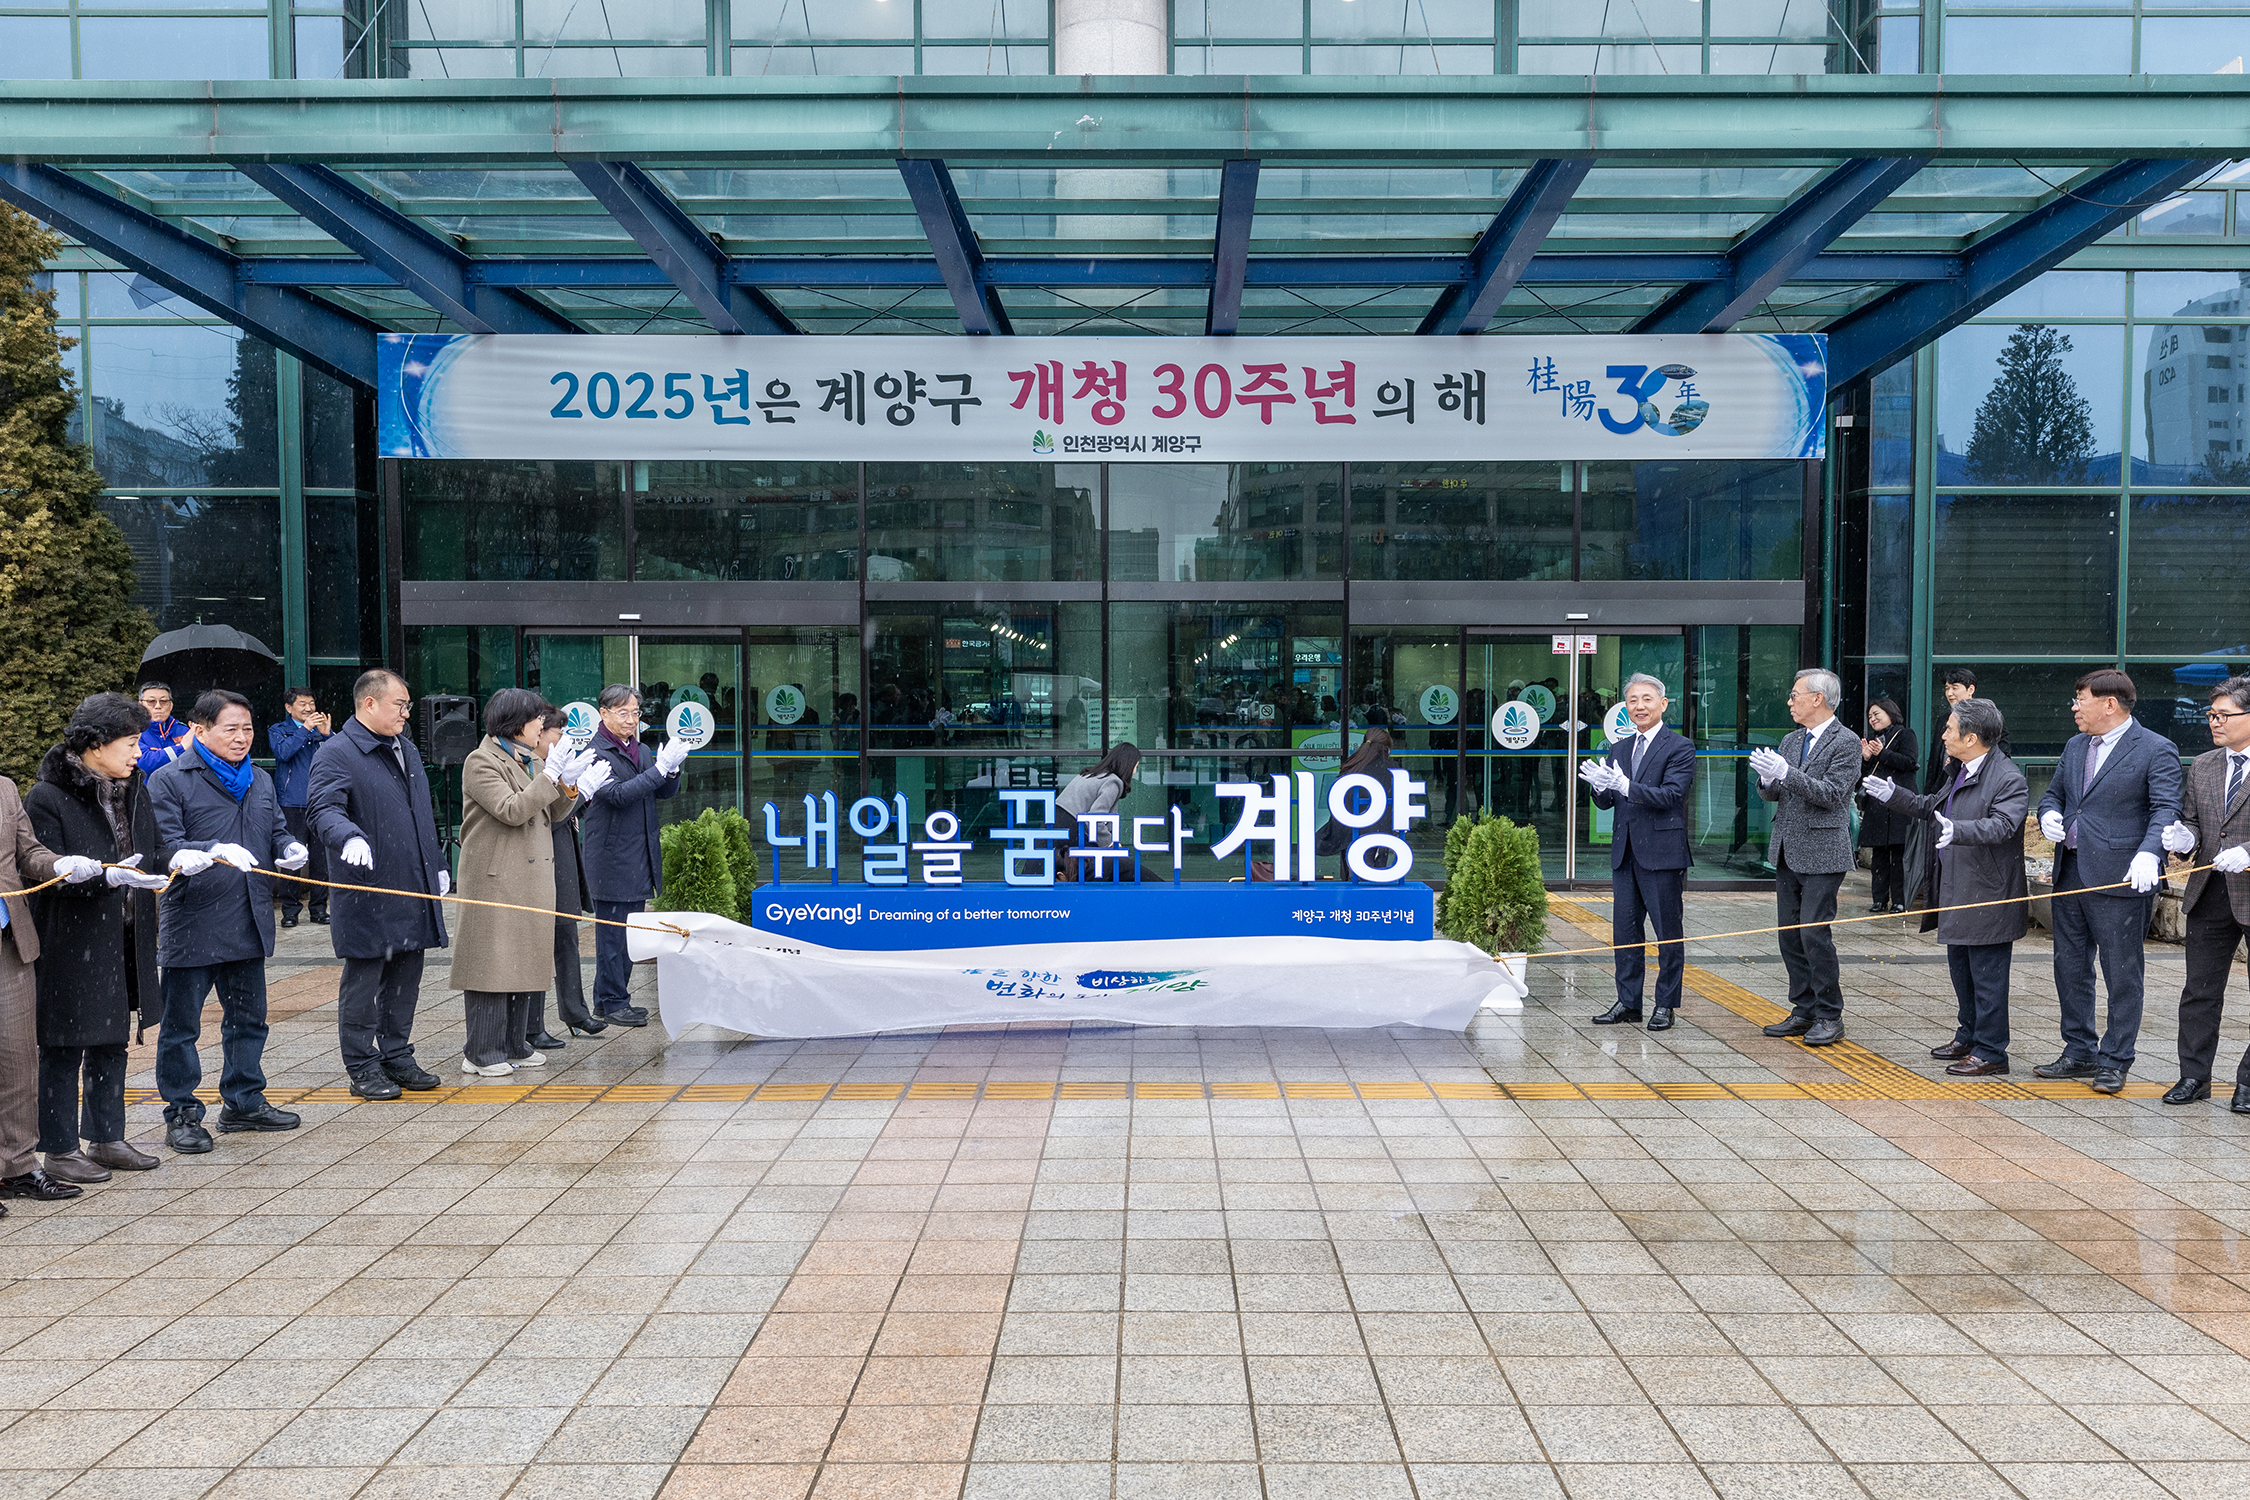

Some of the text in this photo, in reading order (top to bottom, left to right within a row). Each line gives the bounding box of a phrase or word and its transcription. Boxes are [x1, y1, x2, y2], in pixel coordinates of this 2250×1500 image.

[549, 368, 801, 427] 2025년은
[815, 369, 982, 427] 계양구
[1007, 360, 1128, 426] 개청
[1433, 369, 1487, 426] 해
[1062, 435, 1202, 453] 인천광역시 계양구
[1294, 653, 1321, 662] 우리은행
[1504, 736, 1529, 744] 계양구
[762, 790, 974, 887] 내일을
[1209, 767, 1428, 884] 계양
[765, 903, 1071, 925] GyeYang! Dreaming of a better tomorrow
[1291, 909, 1326, 924] 계양구
[1329, 909, 1352, 924] 개청
[985, 979, 1066, 1000] 변화의
